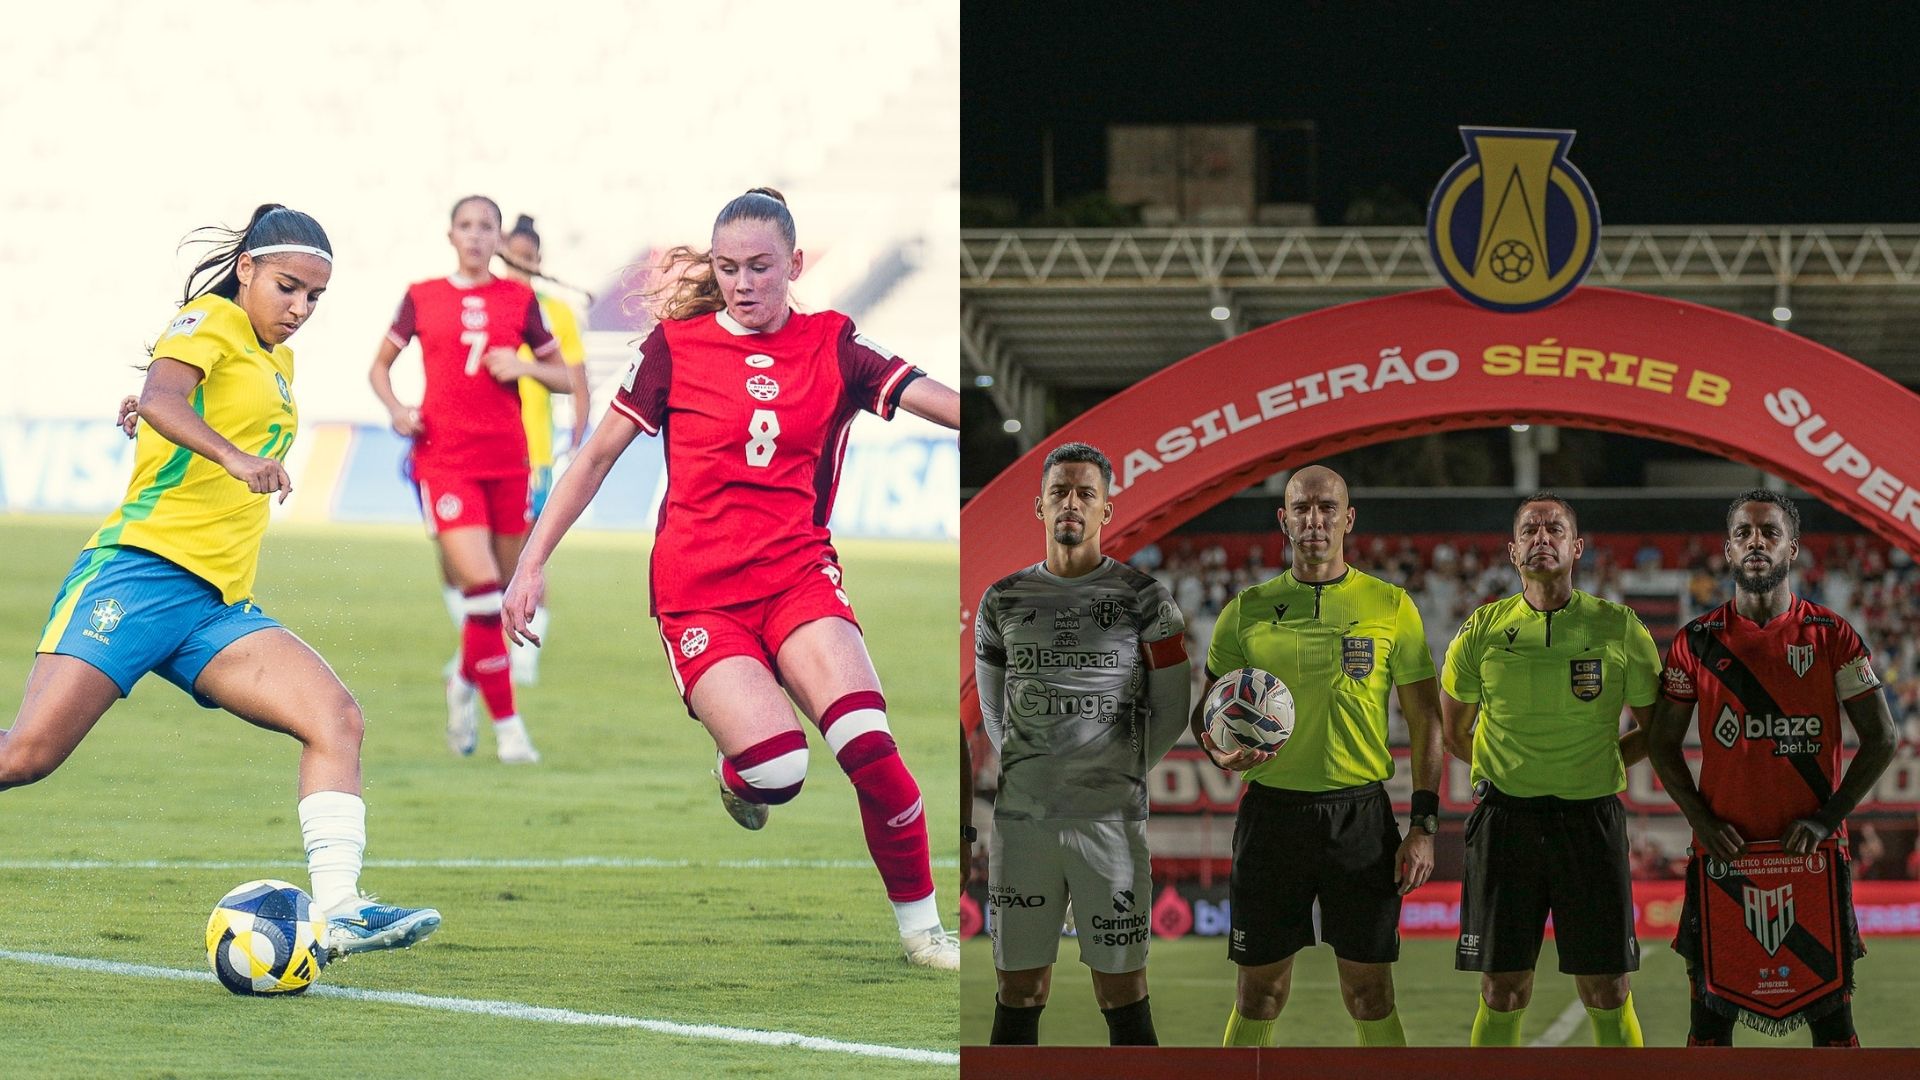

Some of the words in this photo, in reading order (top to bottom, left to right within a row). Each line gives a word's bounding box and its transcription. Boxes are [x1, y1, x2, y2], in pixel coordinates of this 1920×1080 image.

[460, 331, 489, 376] 7
[1109, 346, 1459, 497] ASILEIRÃO
[1482, 337, 1680, 394] SÉRIE
[1686, 369, 1732, 408] B
[745, 409, 781, 468] 8
[82, 629, 110, 646] BRASIL
[1347, 640, 1369, 649] CBF
[1041, 651, 1119, 670] Banpará
[1575, 662, 1597, 672] CBF
[1015, 679, 1119, 719] Ginga
[1745, 713, 1821, 738] blaze
[1775, 740, 1821, 754] .bet.br
[990, 893, 1046, 908] APÃO
[1091, 911, 1147, 930] Carimbó
[1104, 928, 1149, 946] sorte
[1232, 928, 1246, 943] BF
[1460, 934, 1480, 947] CBF
